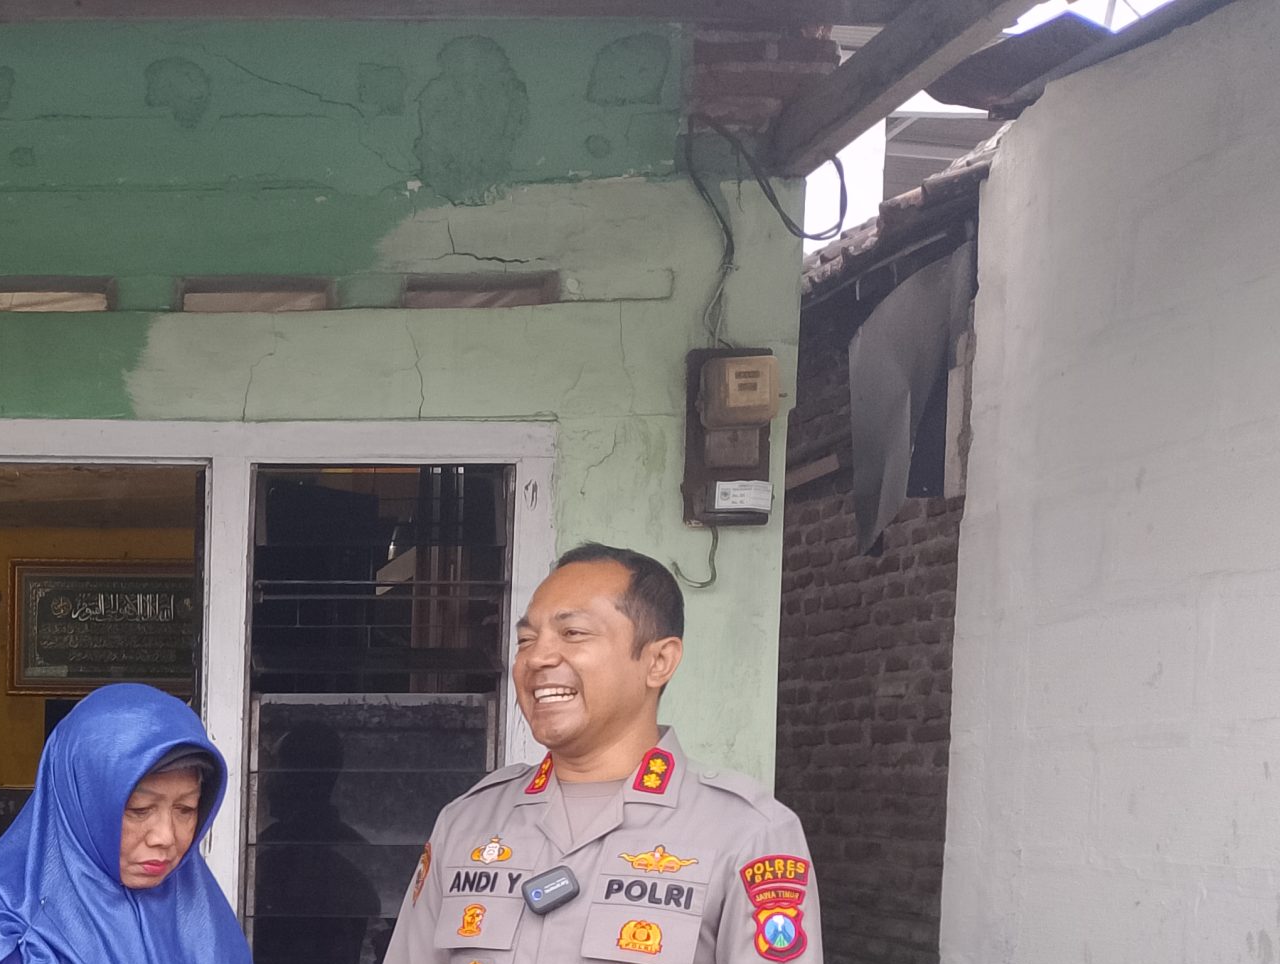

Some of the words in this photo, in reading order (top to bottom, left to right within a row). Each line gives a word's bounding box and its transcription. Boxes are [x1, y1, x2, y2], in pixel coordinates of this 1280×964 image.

[745, 859, 806, 882] POLRES
[754, 869, 795, 884] BATU
[449, 871, 498, 893] ANDI
[507, 872, 522, 894] Y
[604, 879, 694, 910] POLRI
